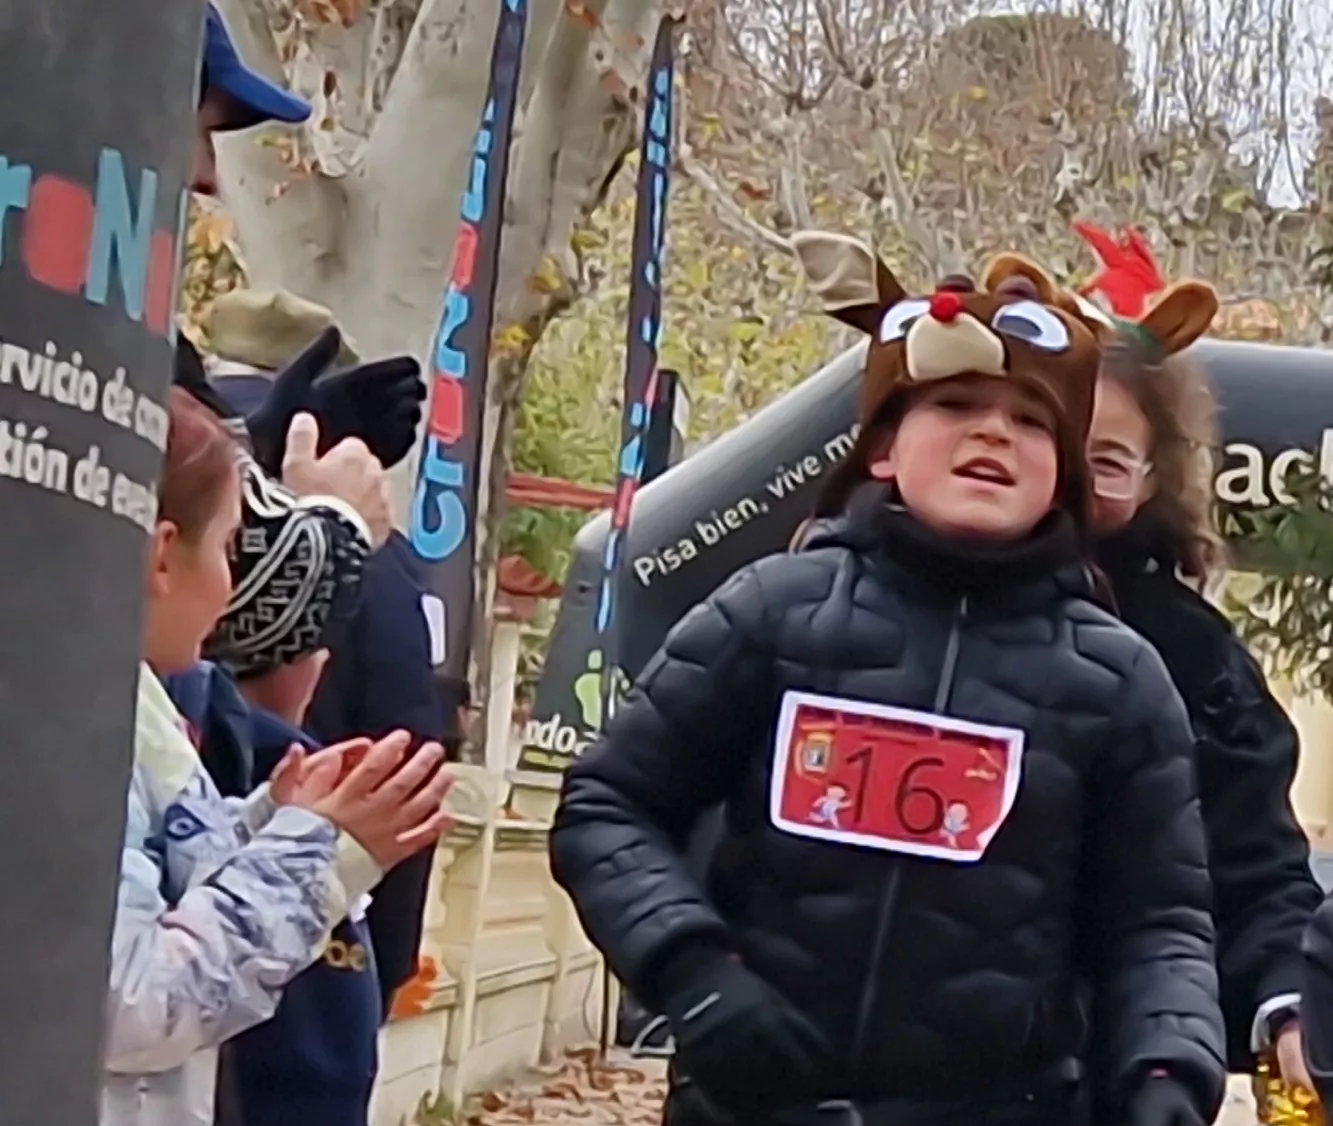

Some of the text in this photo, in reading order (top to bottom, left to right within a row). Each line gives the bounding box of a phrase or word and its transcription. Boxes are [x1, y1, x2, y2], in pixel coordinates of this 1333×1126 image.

[0, 339, 99, 412] rvicio
[102, 366, 135, 429] de
[74, 444, 111, 508] de
[633, 538, 698, 587] Pisa
[696, 498, 770, 545] bien,
[768, 456, 821, 500] vive
[846, 747, 945, 836] 16
